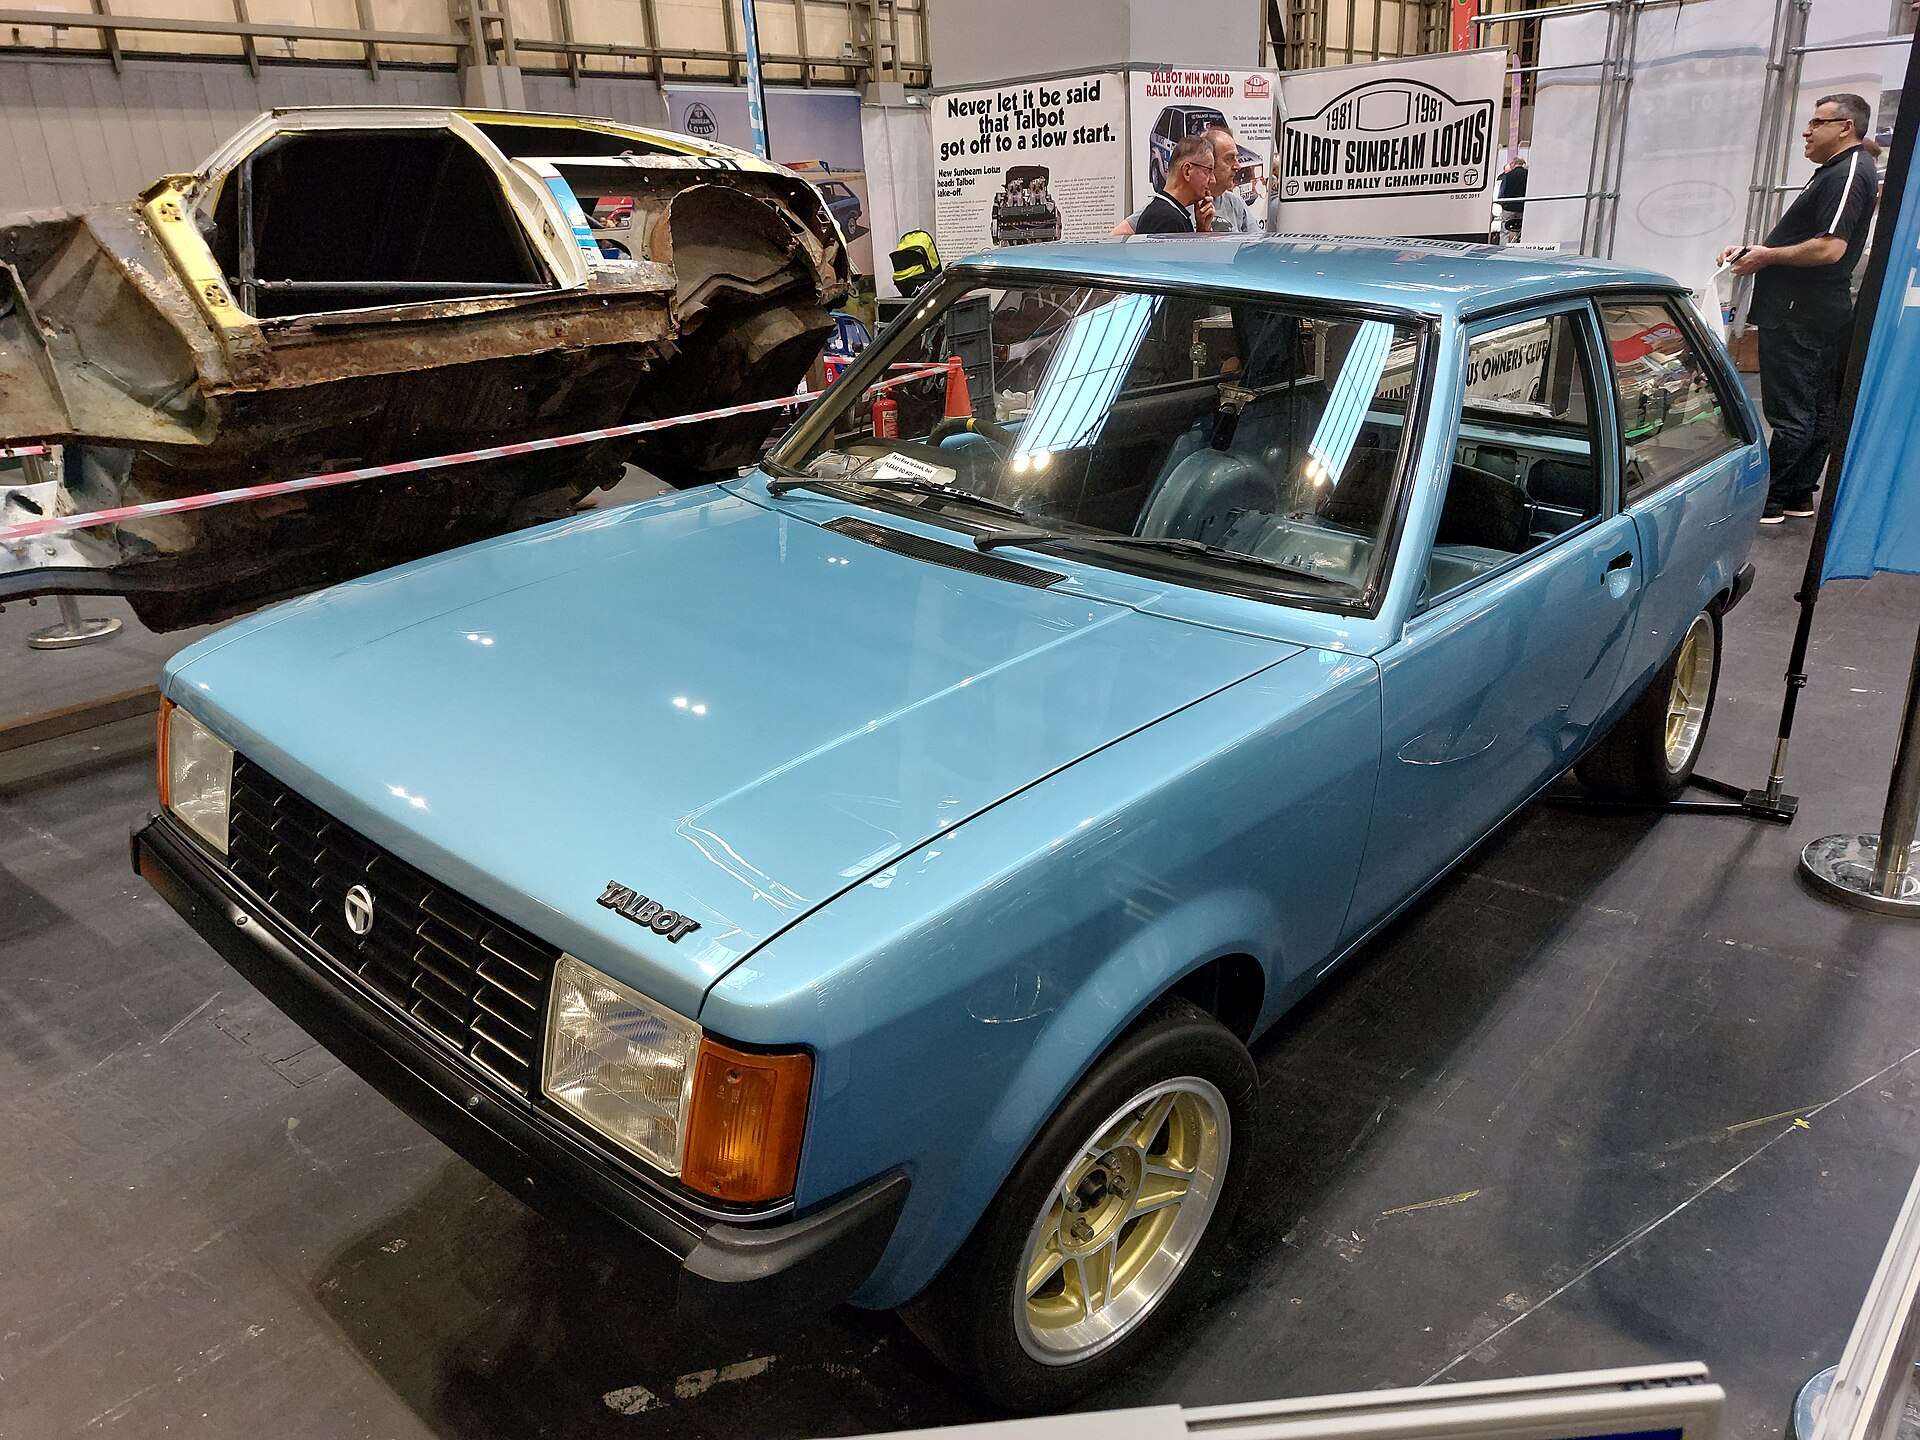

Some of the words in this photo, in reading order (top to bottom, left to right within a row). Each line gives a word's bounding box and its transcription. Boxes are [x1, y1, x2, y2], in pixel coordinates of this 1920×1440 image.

[1151, 72, 1182, 84] TALBOT
[1185, 72, 1200, 83] WIN
[1202, 73, 1230, 84] WORLD
[948, 98, 992, 118] Never
[998, 92, 1018, 112] let
[1024, 89, 1034, 110] it
[1040, 87, 1061, 106] be
[1067, 80, 1100, 104] said
[1147, 85, 1171, 97] RALLY
[1173, 86, 1234, 98] CHAMPIONSHIP
[1326, 100, 1353, 131] 1981
[1415, 92, 1443, 123] 1981
[689, 124, 714, 133] LOTUS
[979, 115, 1008, 133] that
[1014, 108, 1065, 130] Talbot
[941, 138, 964, 161] got
[970, 134, 991, 154] off
[996, 134, 1012, 152] to
[1018, 135, 1026, 150] a
[1032, 128, 1067, 148] slow
[1073, 123, 1116, 144] start.
[1286, 127, 1340, 177] TALBOT
[1345, 132, 1426, 174] SUNBEAM
[1432, 108, 1487, 168] LOTUS
[938, 169, 952, 178] New
[954, 168, 982, 177] Sunbeam
[984, 166, 1001, 174] Lotus
[1304, 180, 1343, 192] WORLD
[1347, 176, 1380, 190] RALLY
[1385, 172, 1460, 188] CHAMPIONS
[937, 179, 955, 187] heads
[956, 178, 975, 186] Talbot
[938, 188, 962, 197] take-off.
[884, 462, 899, 471] PLEASE
[596, 880, 702, 944] TALBOT
